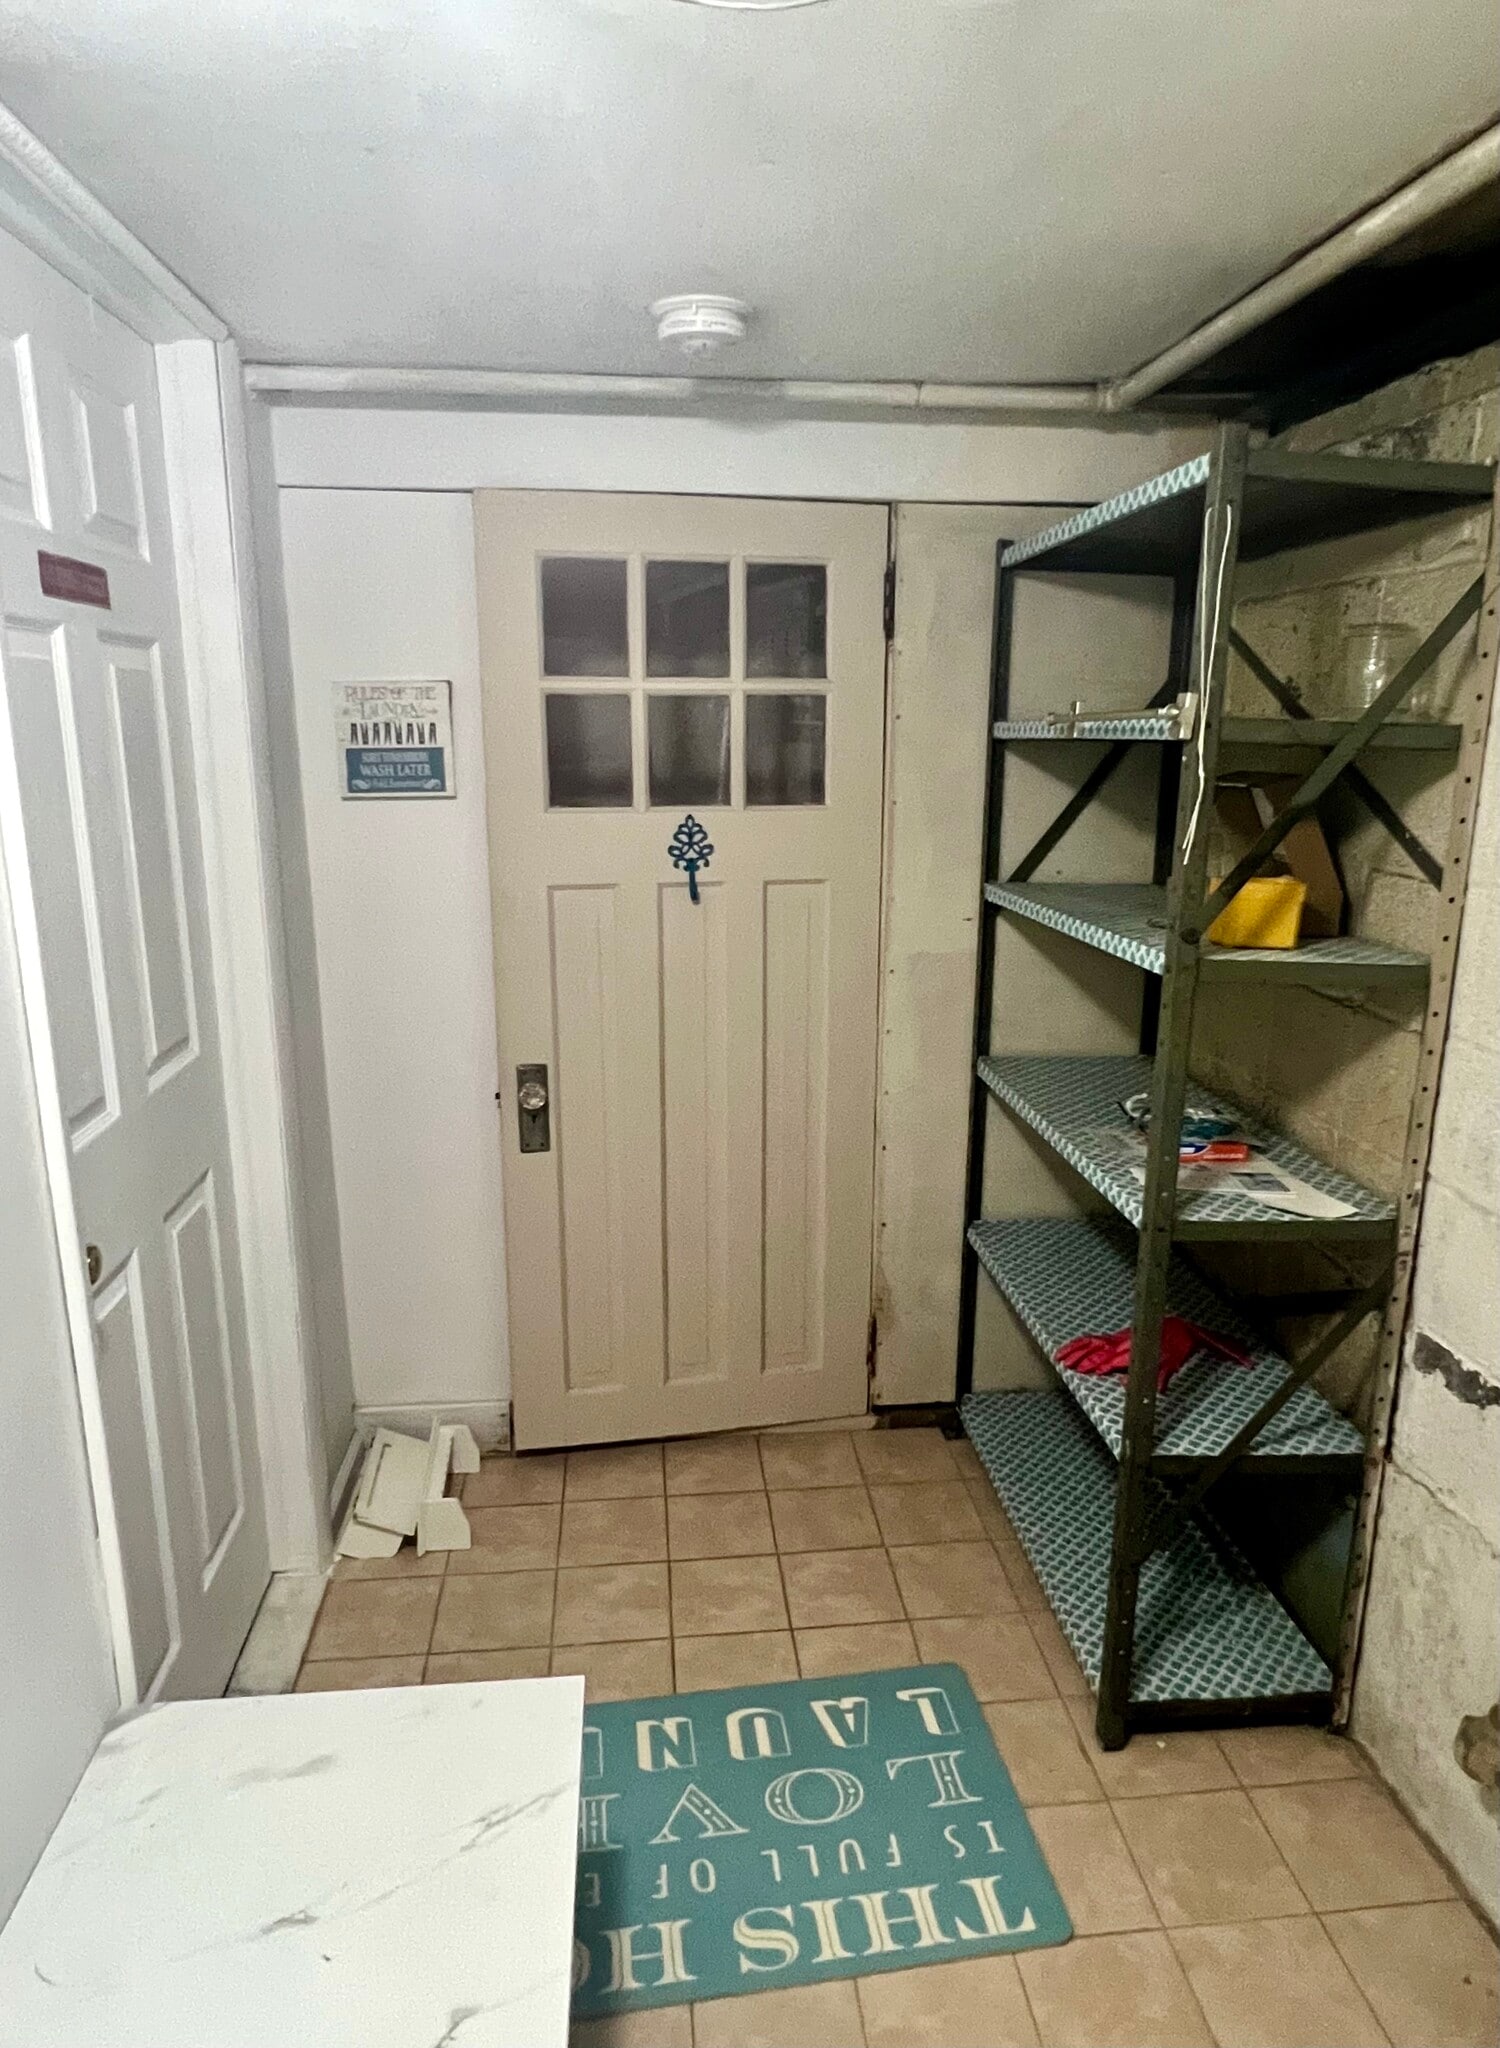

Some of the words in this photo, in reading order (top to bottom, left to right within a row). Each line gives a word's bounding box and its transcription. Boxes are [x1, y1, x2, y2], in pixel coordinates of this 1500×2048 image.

[360, 763, 395, 777] WASH
[396, 763, 433, 777] LATER
[581, 1686, 961, 1779] LAUN
[760, 1833, 903, 1882] FULL
[943, 1820, 1006, 1858] IS
[651, 1858, 717, 1899] OF
[733, 1875, 1037, 1974] THIS
